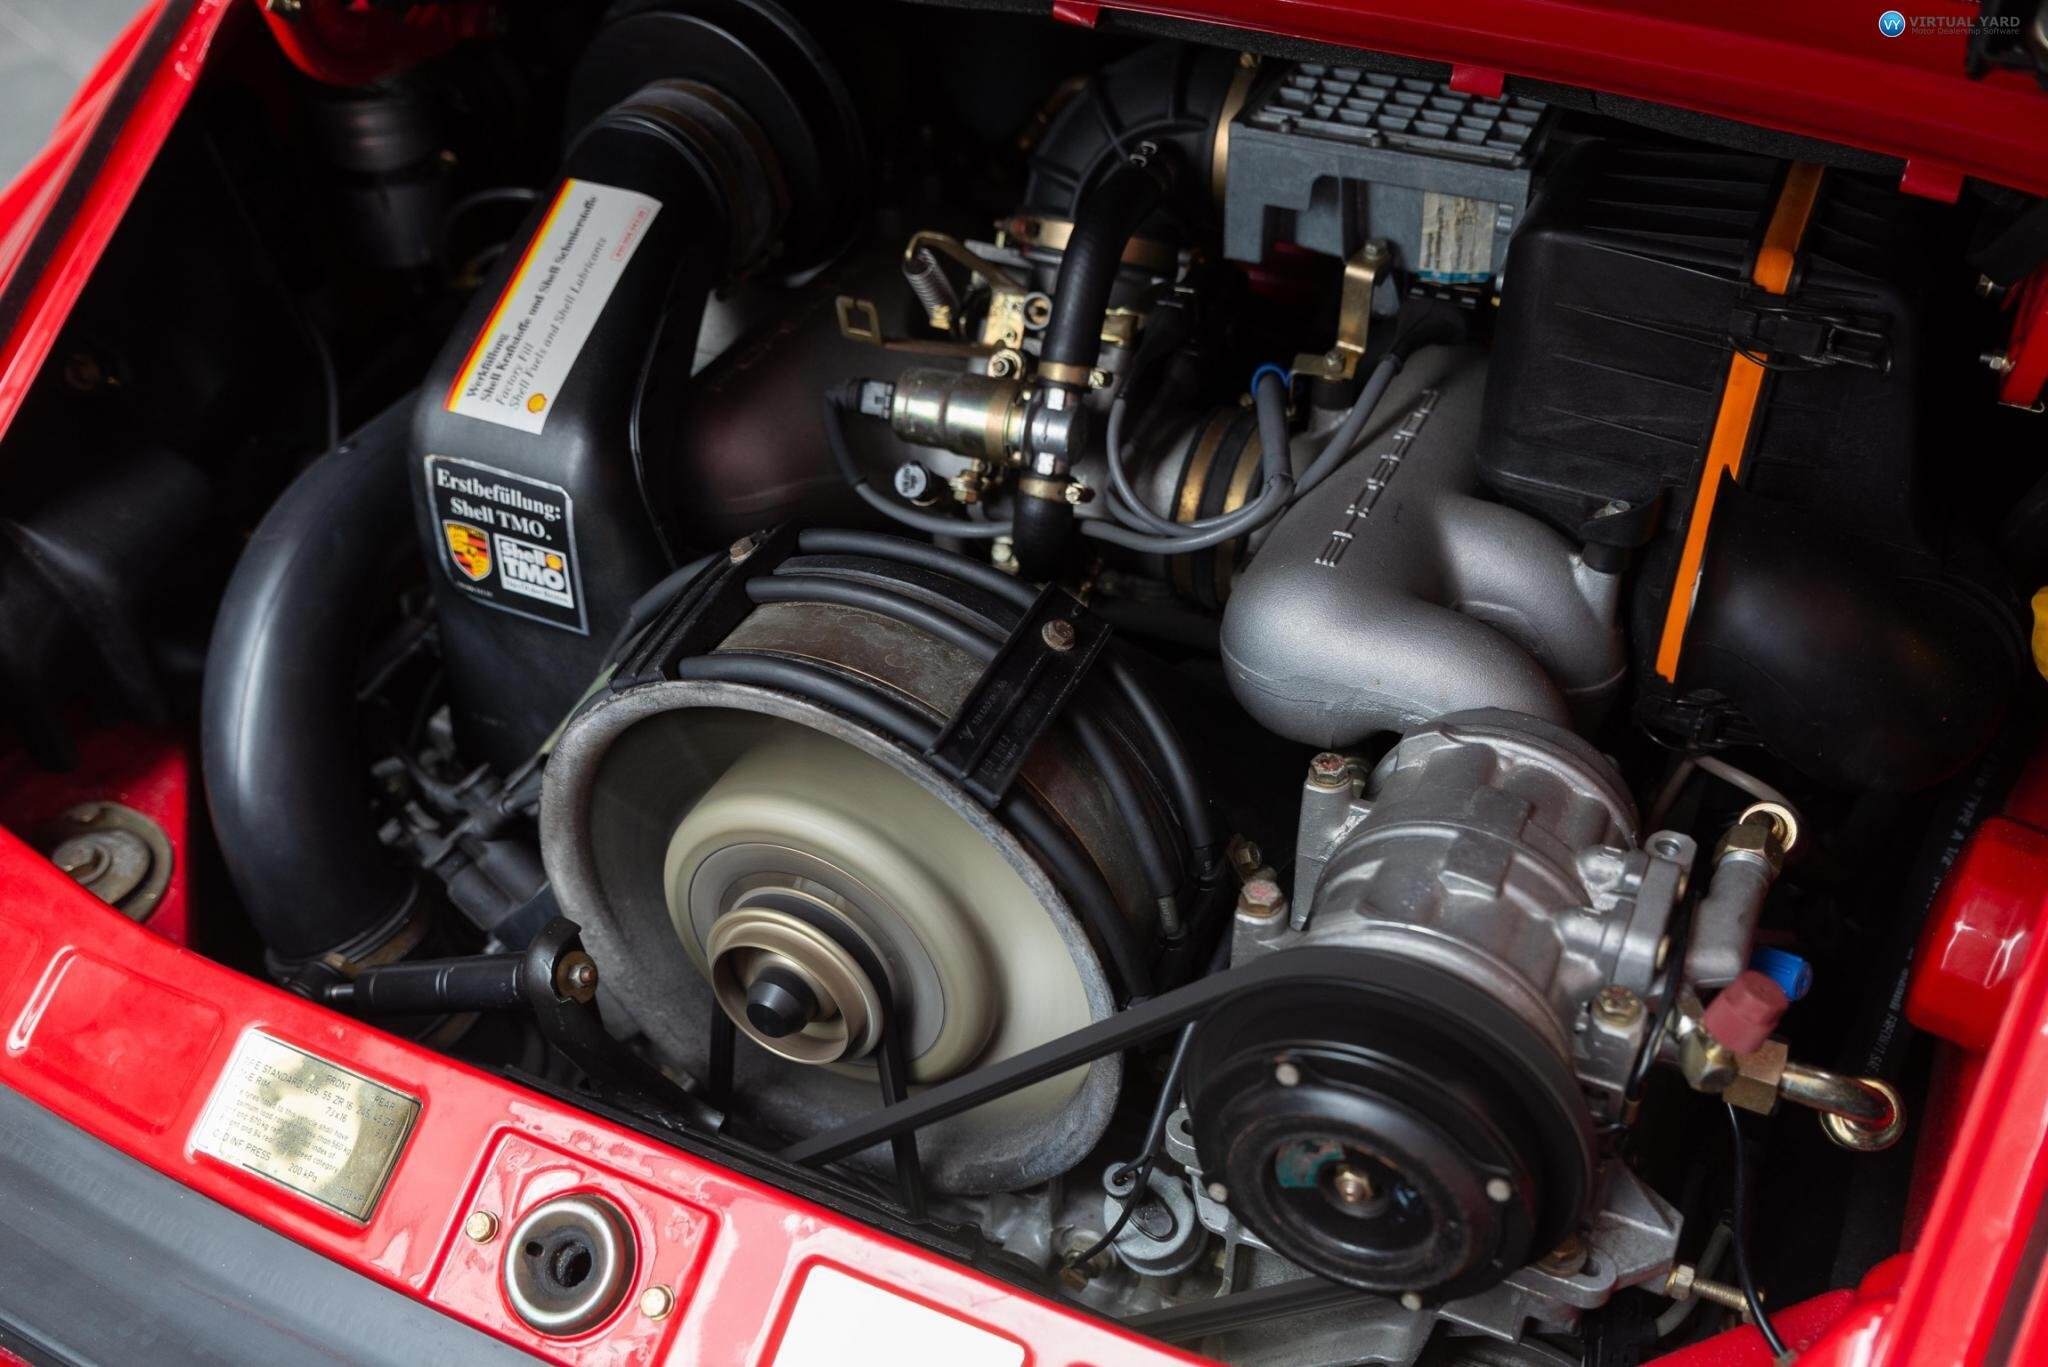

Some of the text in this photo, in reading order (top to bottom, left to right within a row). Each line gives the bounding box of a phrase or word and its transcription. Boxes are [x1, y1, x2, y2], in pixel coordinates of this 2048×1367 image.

[480, 195, 597, 402] Shell Kraftstoffe und Shell Schmierstoffe
[509, 236, 608, 410] Shell Fuels and Shell Lubricants
[466, 333, 510, 398] Werkfüllung
[496, 341, 534, 405] Factory Fill
[436, 468, 561, 522] Erstbefüllung:
[1315, 389, 1441, 567] PORSCHE
[450, 497, 495, 525] Shell
[495, 509, 552, 541] TMO.
[501, 541, 546, 563] Shell
[503, 556, 566, 591] TMO
[255, 1075, 271, 1088] RIM
[261, 1064, 303, 1088] STANDARD
[325, 1074, 351, 1091] FRONT
[244, 1142, 272, 1161] PRESS
